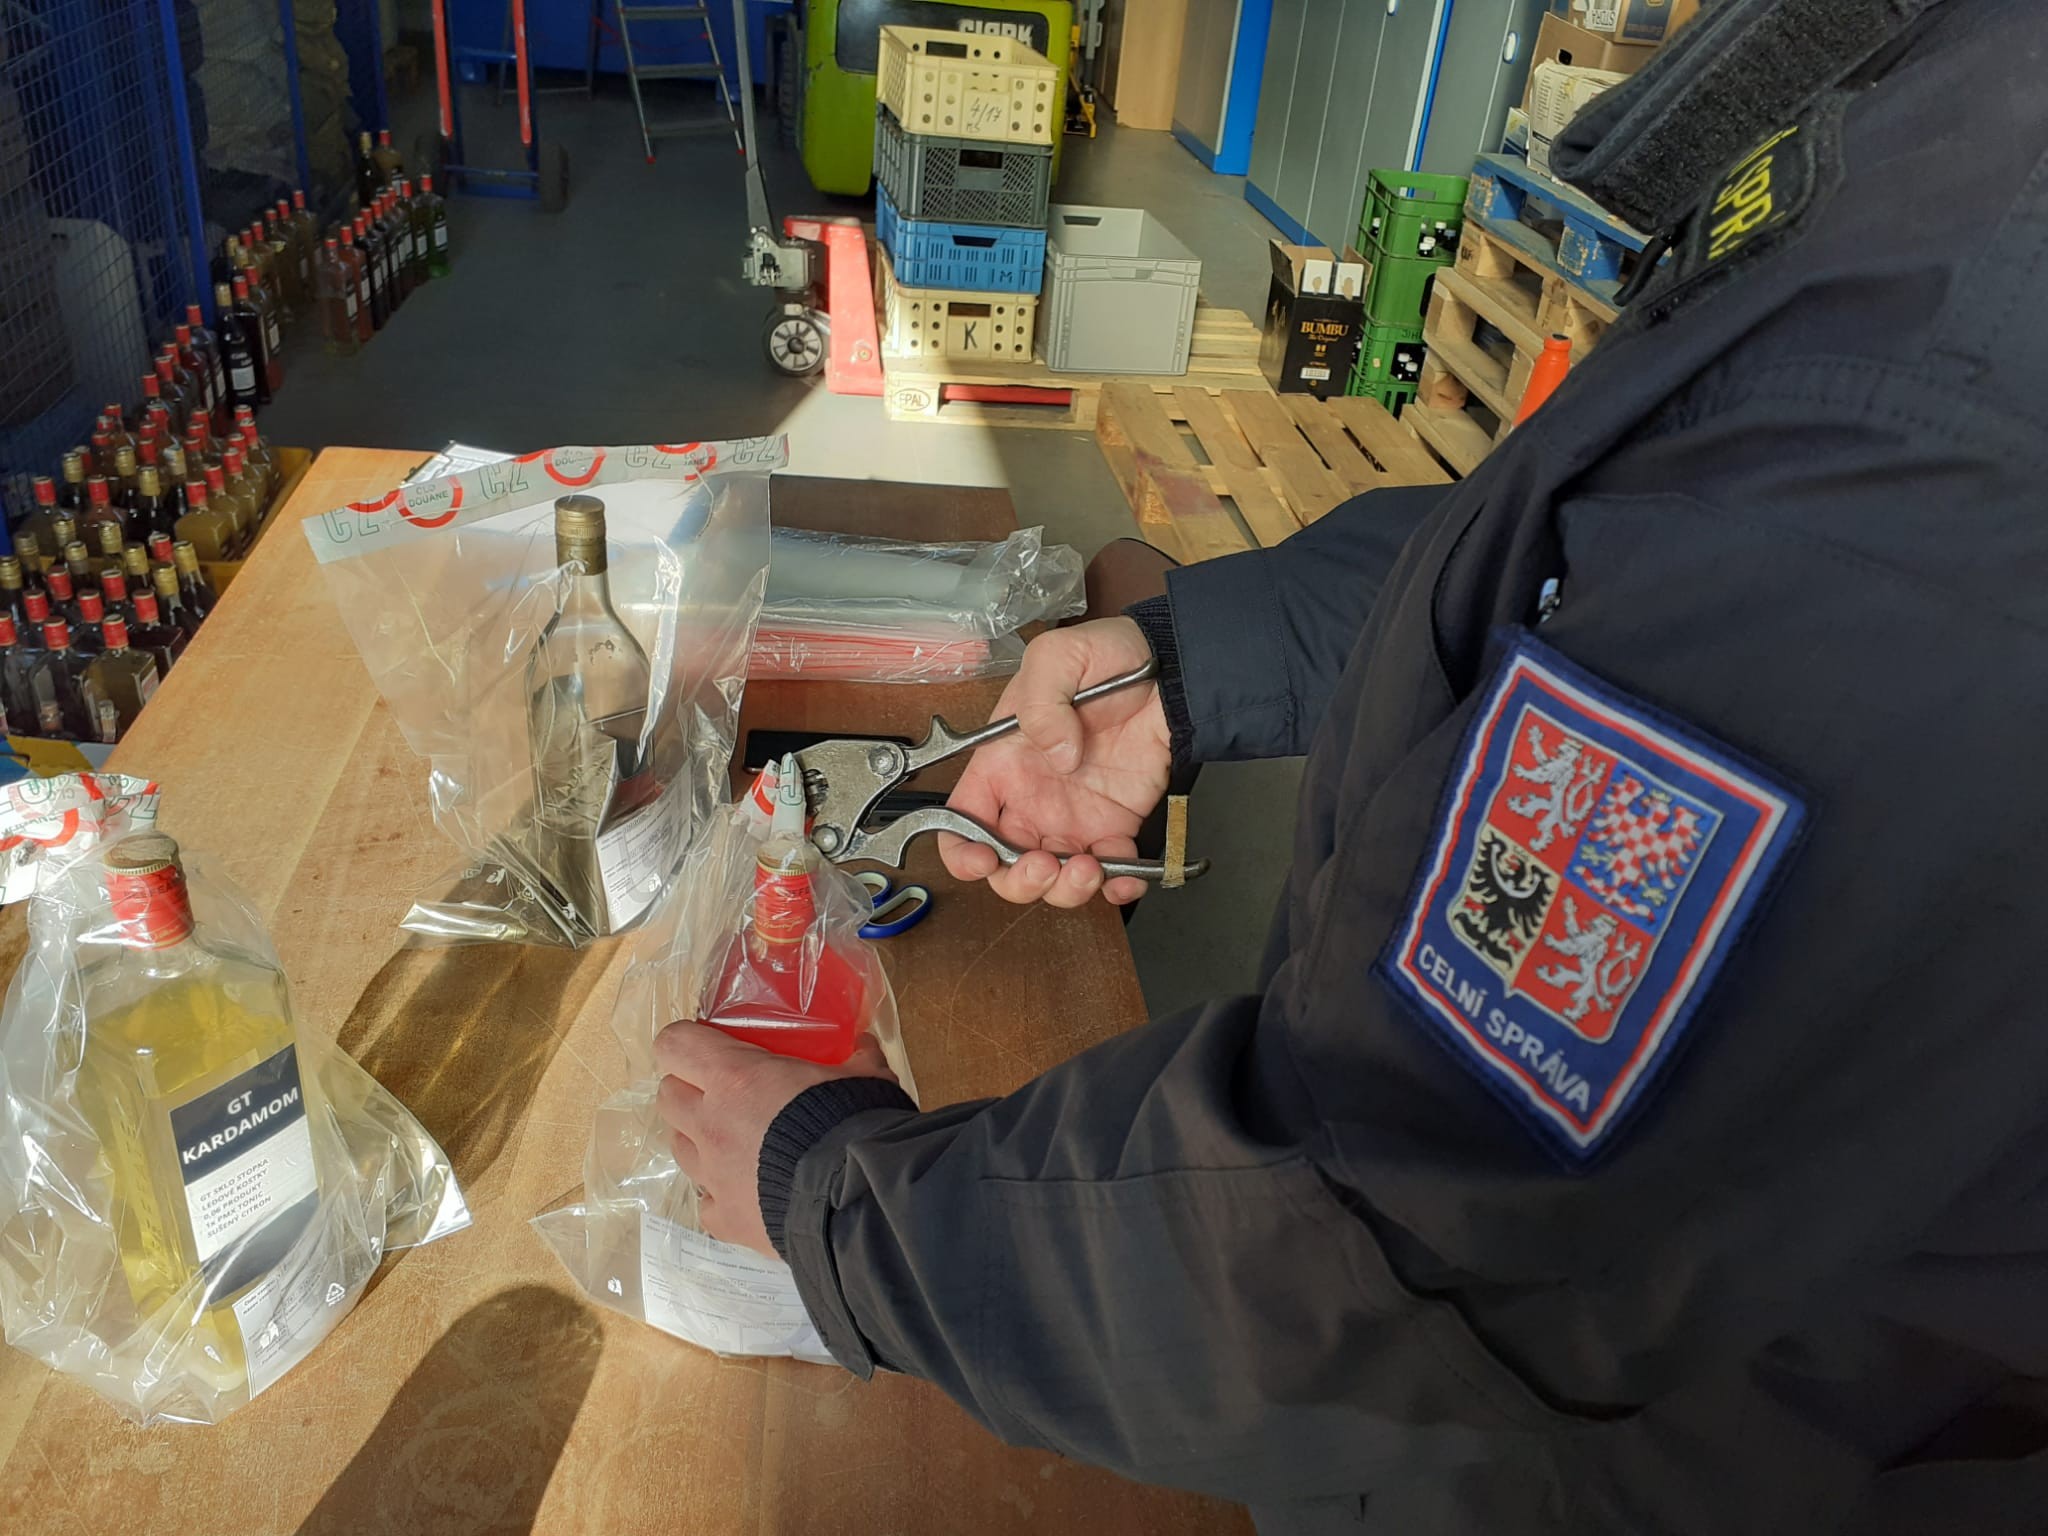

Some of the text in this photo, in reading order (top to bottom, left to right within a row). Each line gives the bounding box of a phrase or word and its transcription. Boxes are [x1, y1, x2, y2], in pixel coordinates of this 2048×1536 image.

[1708, 156, 1786, 260] SPR
[963, 320, 979, 351] K
[1301, 321, 1349, 337] BUMBU
[408, 491, 450, 508] DOUANE
[1419, 944, 1591, 1112] CELNÍ SPRÁVA
[227, 1090, 253, 1116] GT
[182, 1087, 299, 1164] KARDAMOM
[213, 1178, 236, 1194] SKLO
[236, 1158, 269, 1181] STOPKA
[236, 1168, 268, 1192] KOSTKY
[238, 1190, 264, 1210] TONIC
[241, 1195, 272, 1218] CITRON
